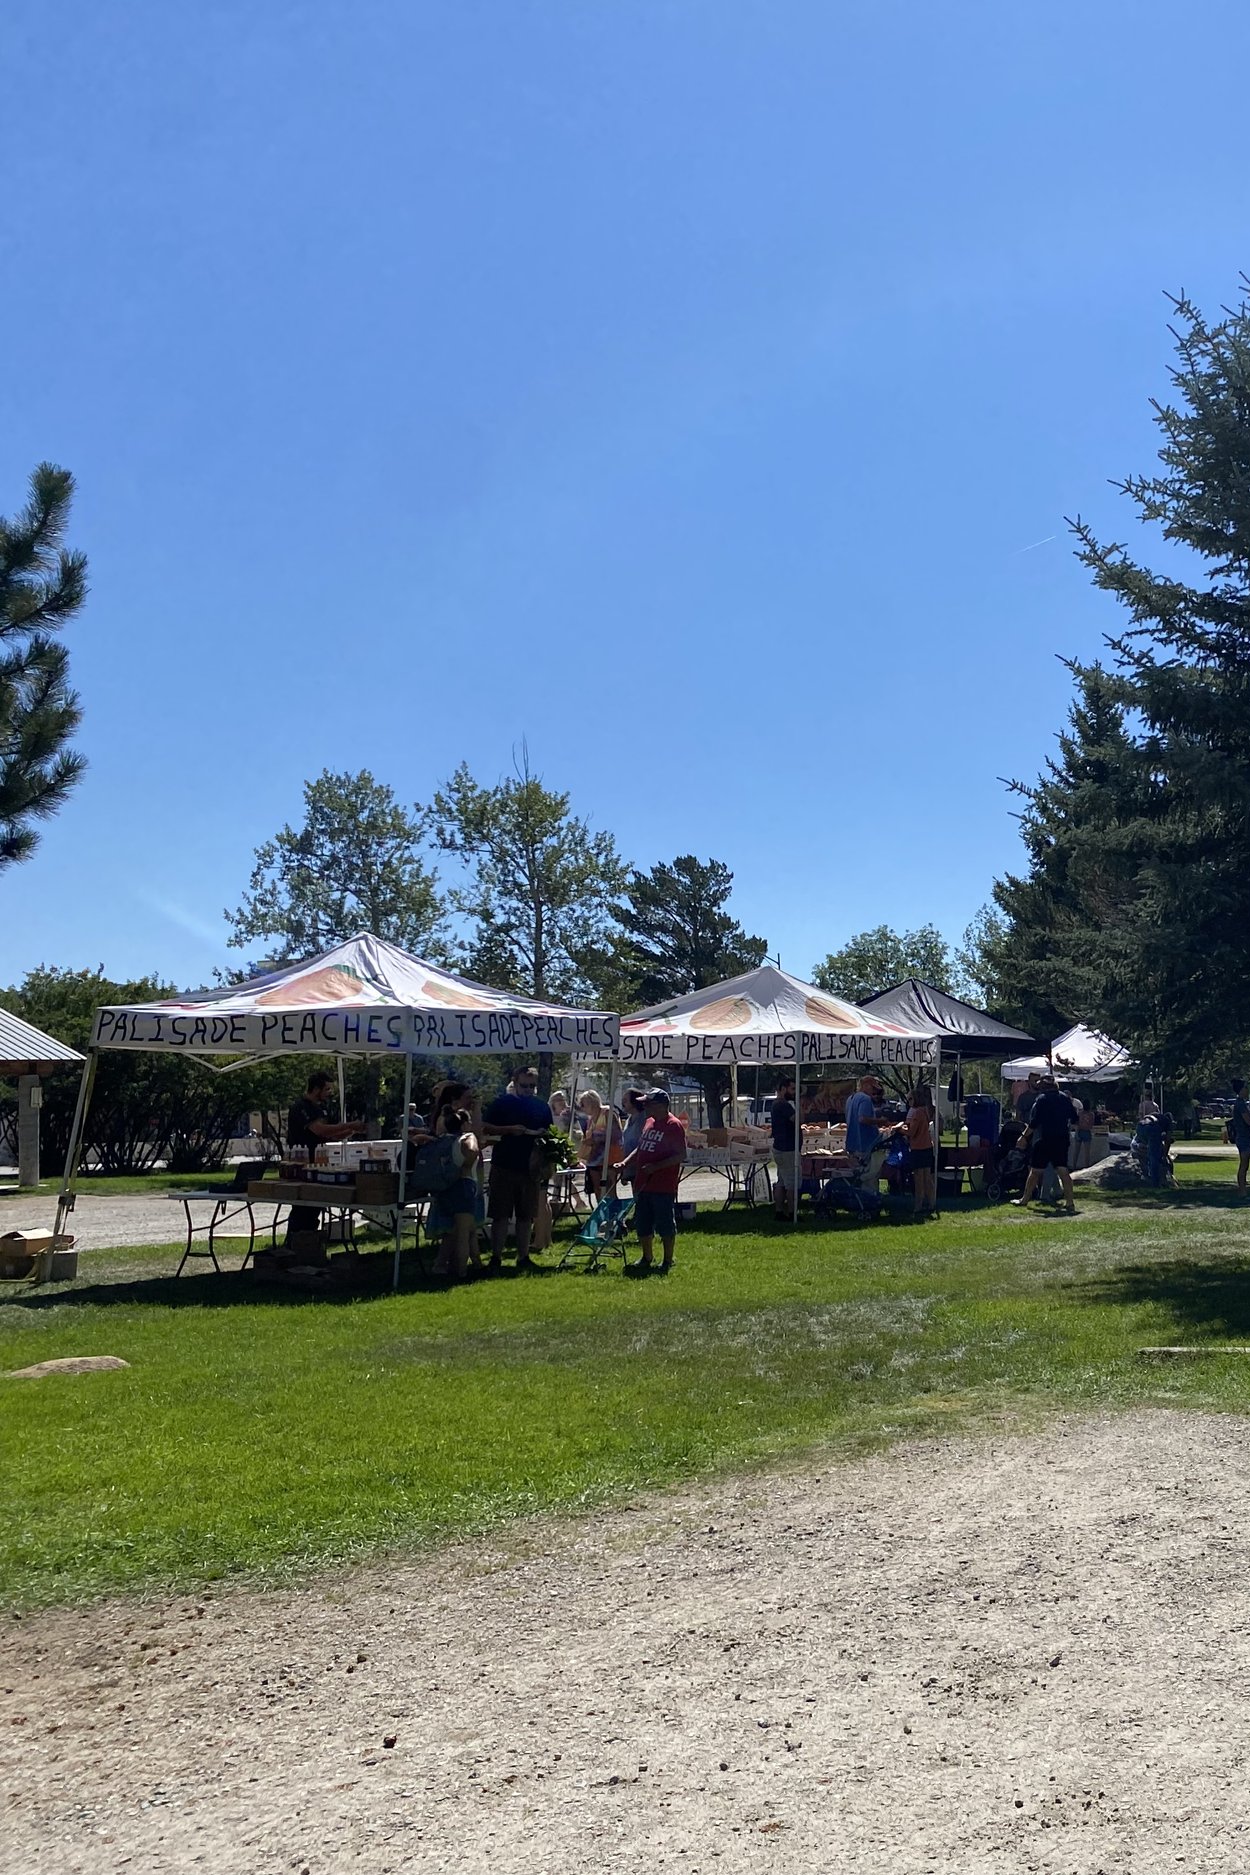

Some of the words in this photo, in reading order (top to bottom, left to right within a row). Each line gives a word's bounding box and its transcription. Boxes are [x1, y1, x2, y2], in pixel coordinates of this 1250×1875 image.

[96, 1010, 247, 1046] PALISADE
[261, 1012, 403, 1048] PEACHES
[685, 1034, 796, 1061] PEACHES
[801, 1033, 874, 1062] PALISADE
[880, 1037, 934, 1065] PEACHES
[639, 1140, 657, 1152] IFE
